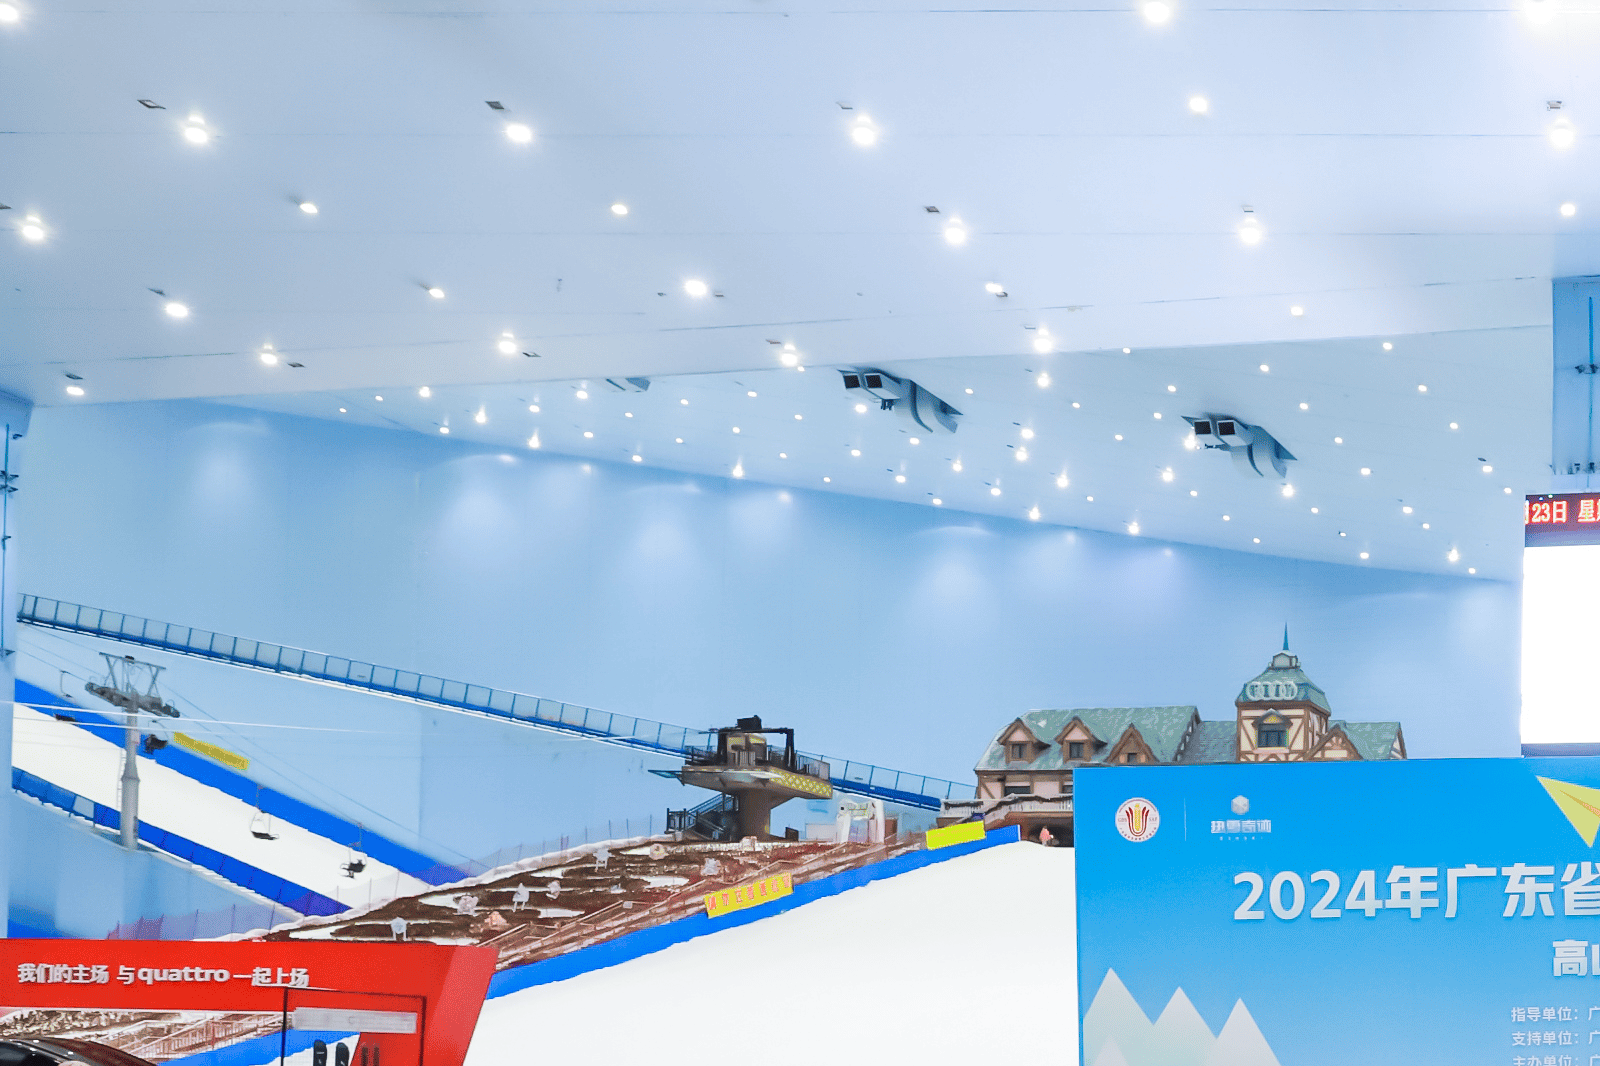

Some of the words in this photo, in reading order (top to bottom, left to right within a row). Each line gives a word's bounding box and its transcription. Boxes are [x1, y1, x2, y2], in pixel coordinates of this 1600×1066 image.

[17, 963, 109, 984] 我们的主场
